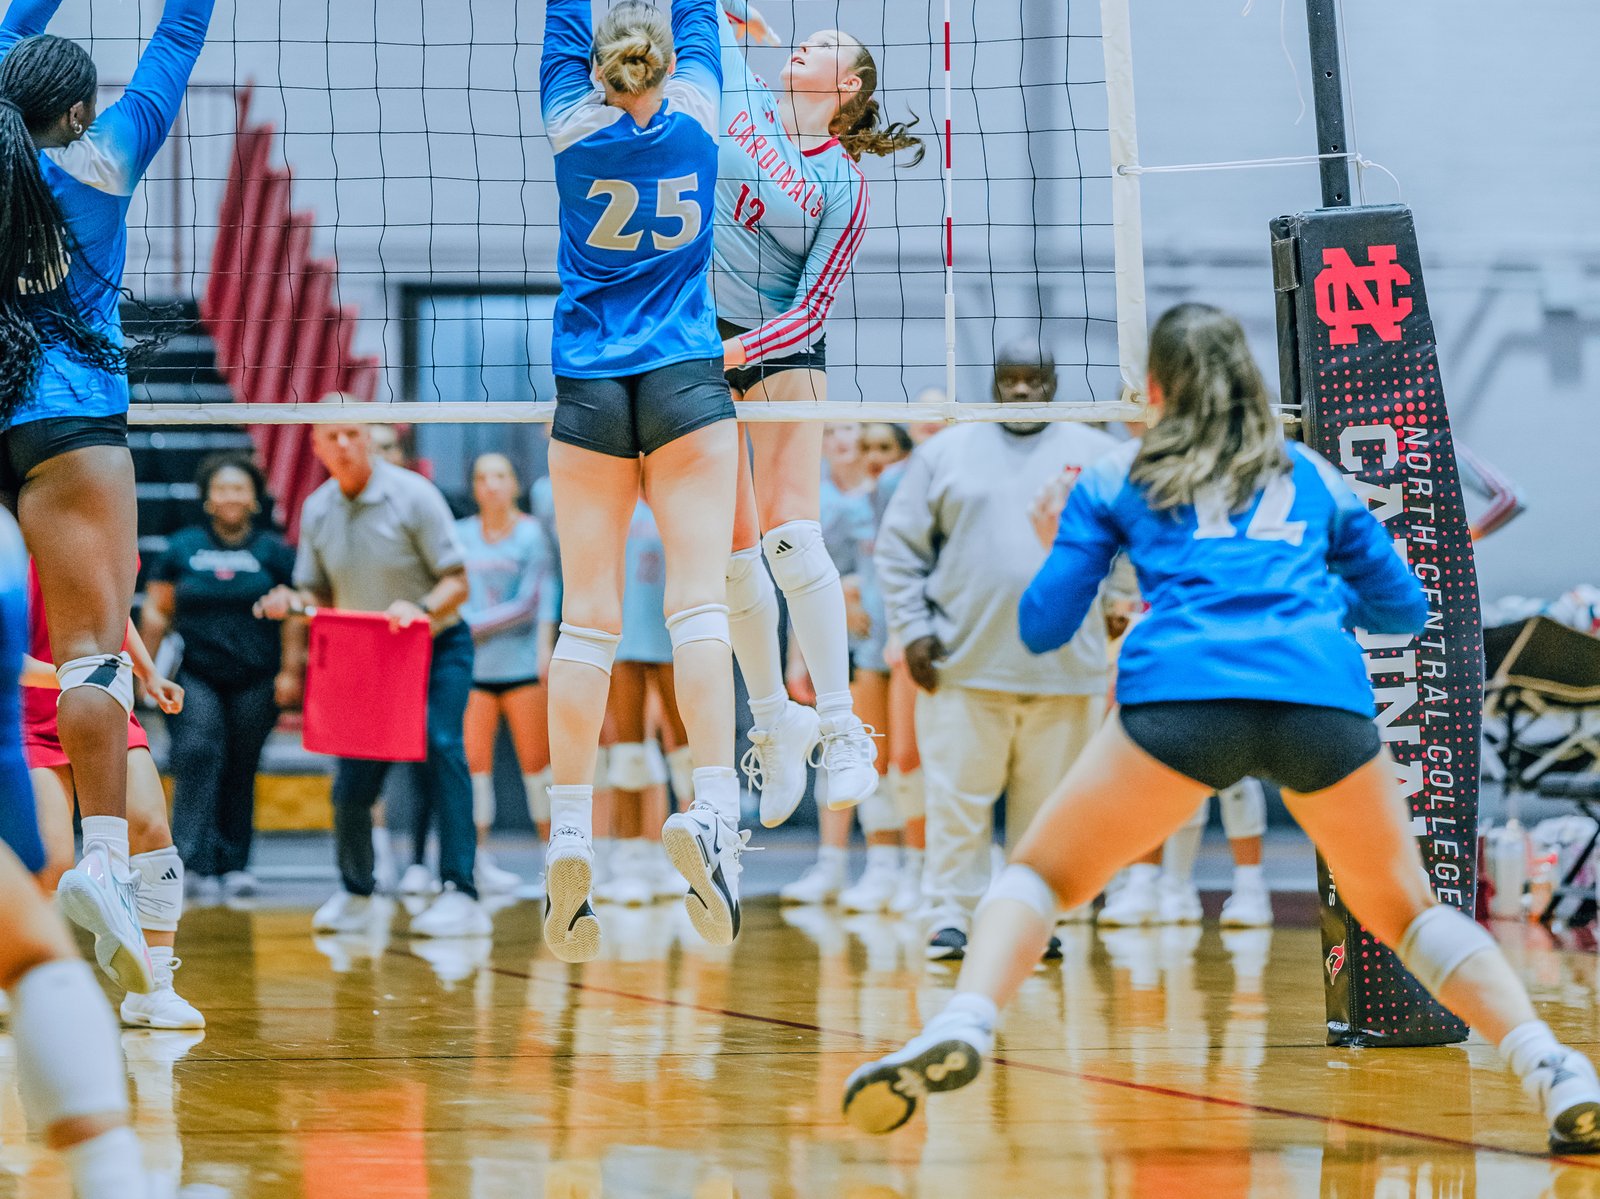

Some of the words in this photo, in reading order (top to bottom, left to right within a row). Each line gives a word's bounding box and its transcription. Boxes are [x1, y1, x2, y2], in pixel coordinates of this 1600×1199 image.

[585, 172, 702, 250] 25
[727, 111, 825, 218] CARDINALS
[733, 183, 766, 234] 12
[1403, 426, 1437, 544] NORTH
[1415, 563, 1451, 725] CENTRAL
[1427, 745, 1463, 906] COLLEGE
